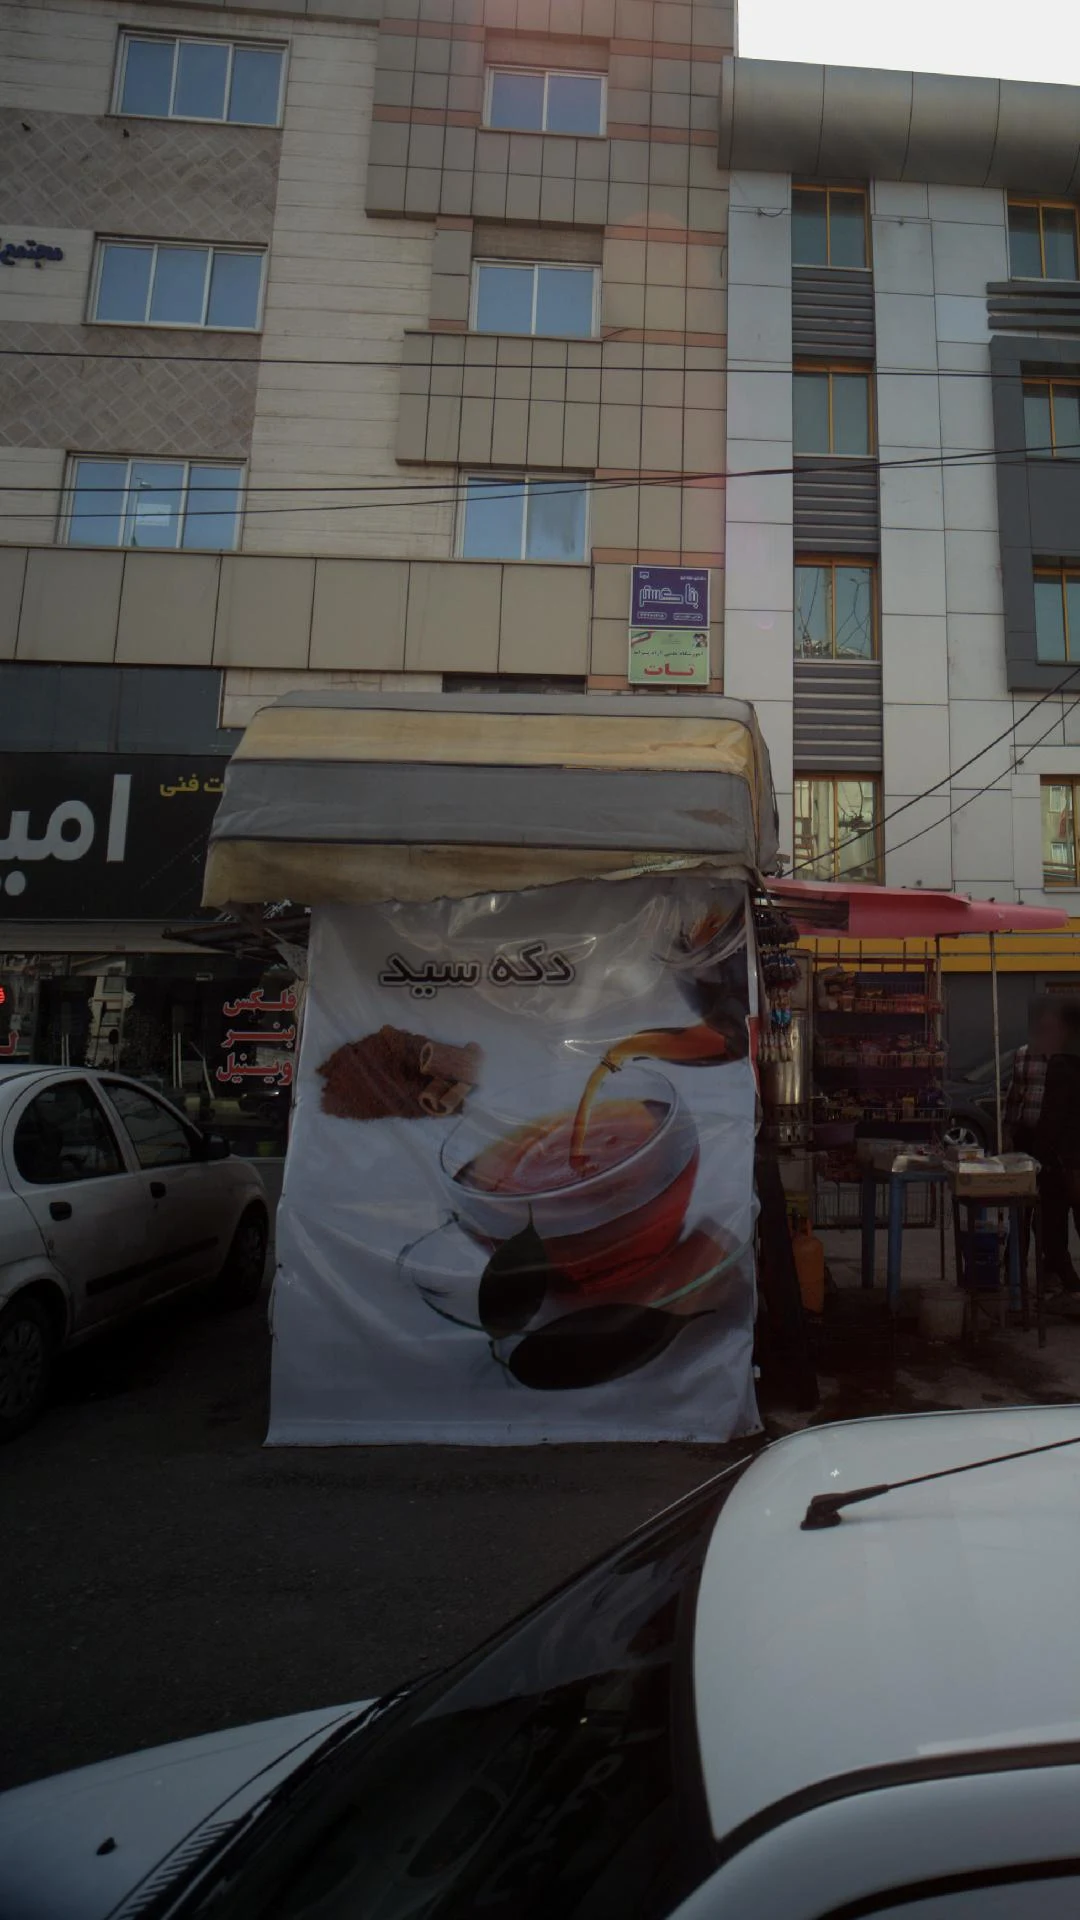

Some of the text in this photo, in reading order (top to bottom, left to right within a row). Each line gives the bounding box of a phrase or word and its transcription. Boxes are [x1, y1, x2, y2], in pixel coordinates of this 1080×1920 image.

[644, 663, 694, 676] تات
[160, 773, 199, 797] فنی
[380, 942, 575, 998] دکه سید
[223, 985, 297, 1016] فلکس
[221, 1022, 295, 1048] بنر
[216, 1052, 293, 1086] وینیل
